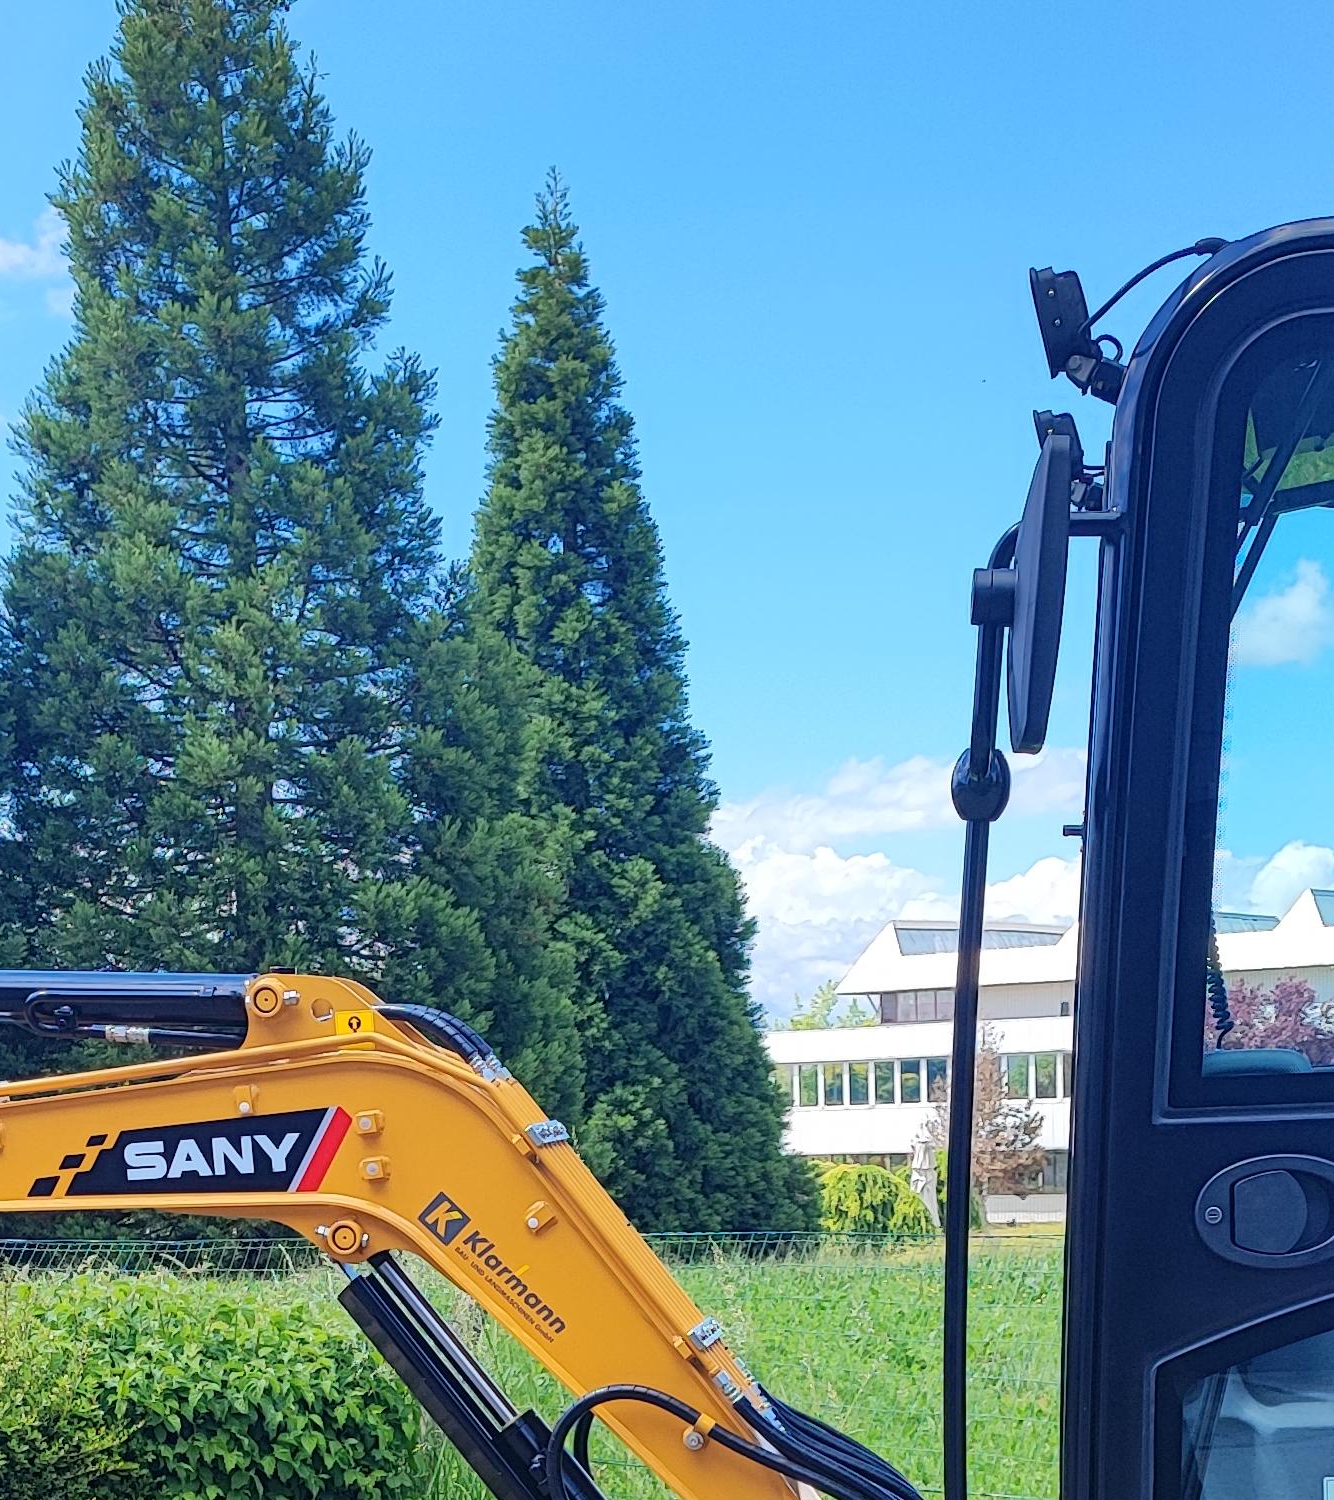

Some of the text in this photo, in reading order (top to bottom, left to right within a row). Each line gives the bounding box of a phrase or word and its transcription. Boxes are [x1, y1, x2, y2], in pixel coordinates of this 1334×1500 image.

[123, 1132, 300, 1181] SANY
[462, 1230, 566, 1334] Klarmann
[484, 1272, 535, 1325] LANDMASCHINEN
